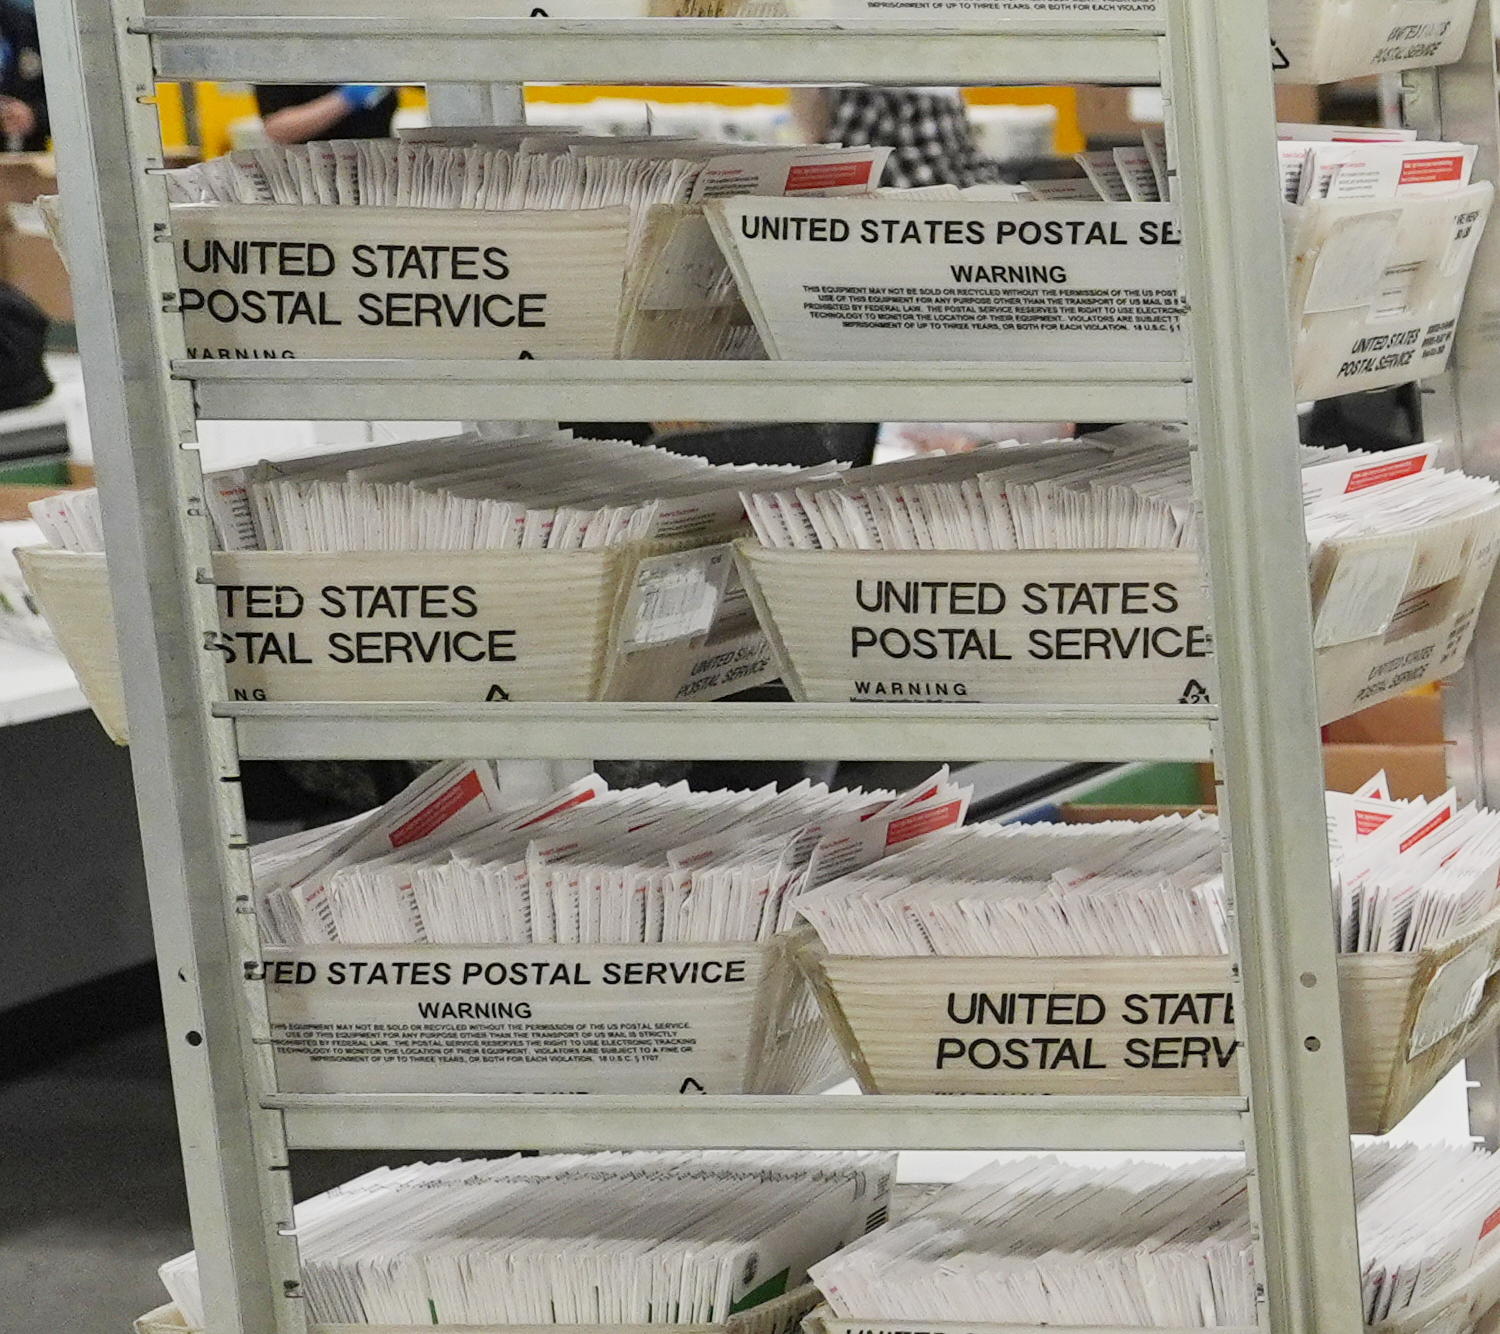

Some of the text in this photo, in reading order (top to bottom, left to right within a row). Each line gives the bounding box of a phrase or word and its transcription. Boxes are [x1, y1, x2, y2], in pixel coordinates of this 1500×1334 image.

[741, 214, 1128, 246] UNITED STATES POSTAL
[182, 238, 510, 281] UNITED STATES
[950, 265, 1067, 284] WARNING
[178, 287, 547, 328] POSTAL SERVICE
[319, 585, 478, 619] STATES
[855, 579, 1179, 615] UNITED STATES
[327, 629, 517, 664] SERVICE
[851, 625, 1214, 661] POSTAL SERVICE
[854, 680, 968, 696] WARNING
[327, 960, 746, 986] STATES POSTAL SERVICE
[417, 1002, 532, 1019] WARNING
[947, 992, 1106, 1026] UNITED
[936, 1036, 1241, 1070] POSTAL SERV
